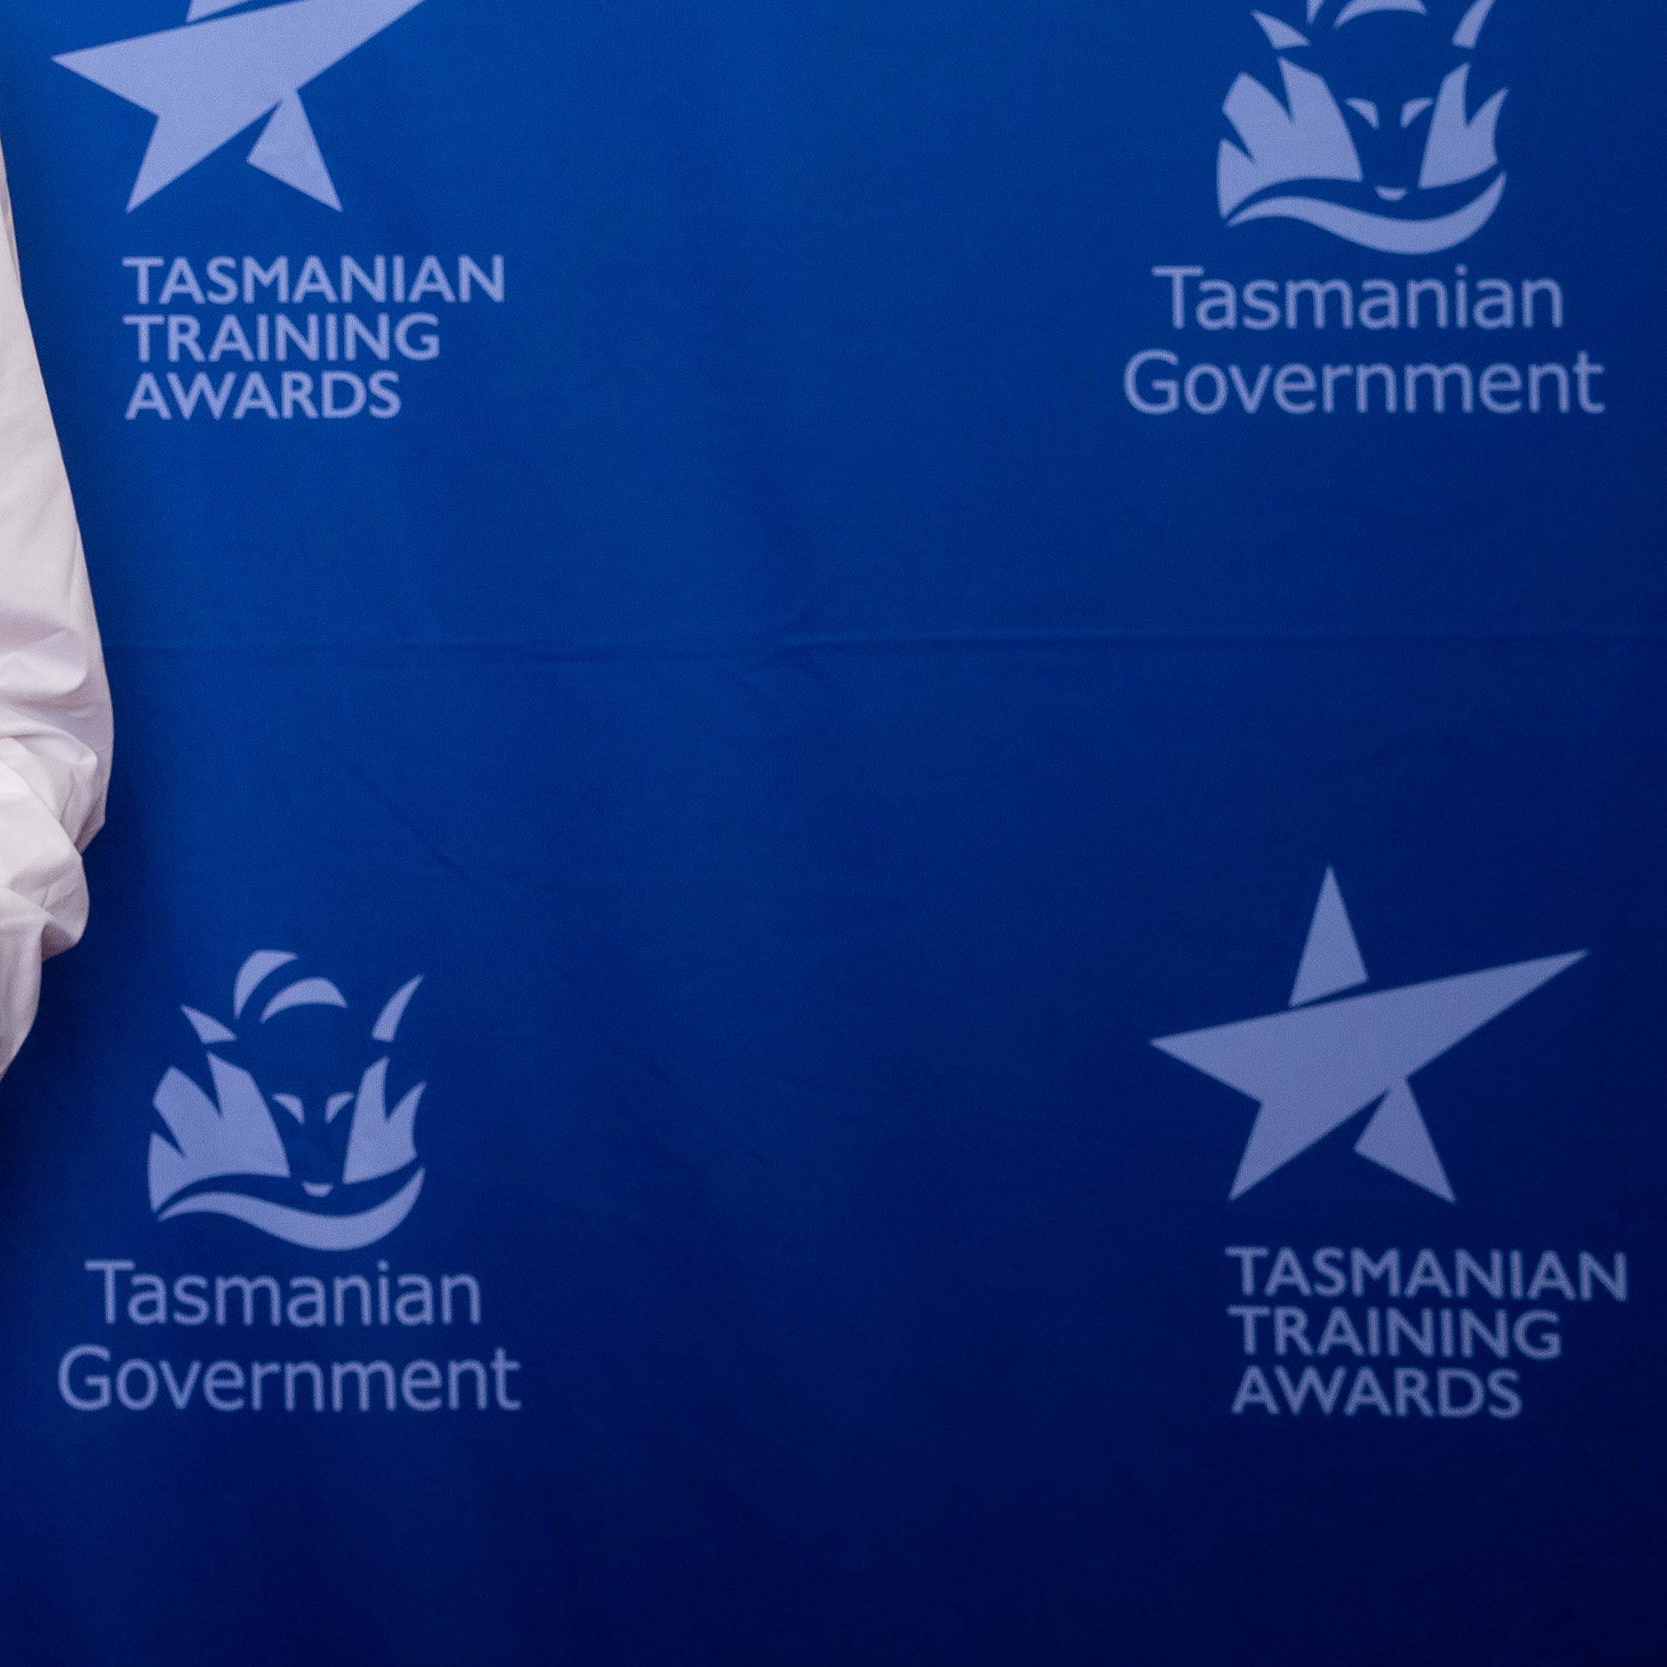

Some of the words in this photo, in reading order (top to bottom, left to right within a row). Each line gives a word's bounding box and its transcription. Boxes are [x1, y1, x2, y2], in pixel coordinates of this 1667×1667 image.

[122, 254, 505, 305] TASMANIAN
[1151, 265, 1563, 330] Tasmanian
[122, 312, 440, 363] TRAINING
[125, 370, 402, 420] AWARDS
[1124, 348, 1605, 415] Government
[84, 1259, 480, 1327] Tasmanian
[1225, 1246, 1626, 1301] TASMANIAN
[1227, 1305, 1561, 1359] TRAINING
[58, 1344, 521, 1412] Government
[1232, 1365, 1522, 1418] AWARDS
